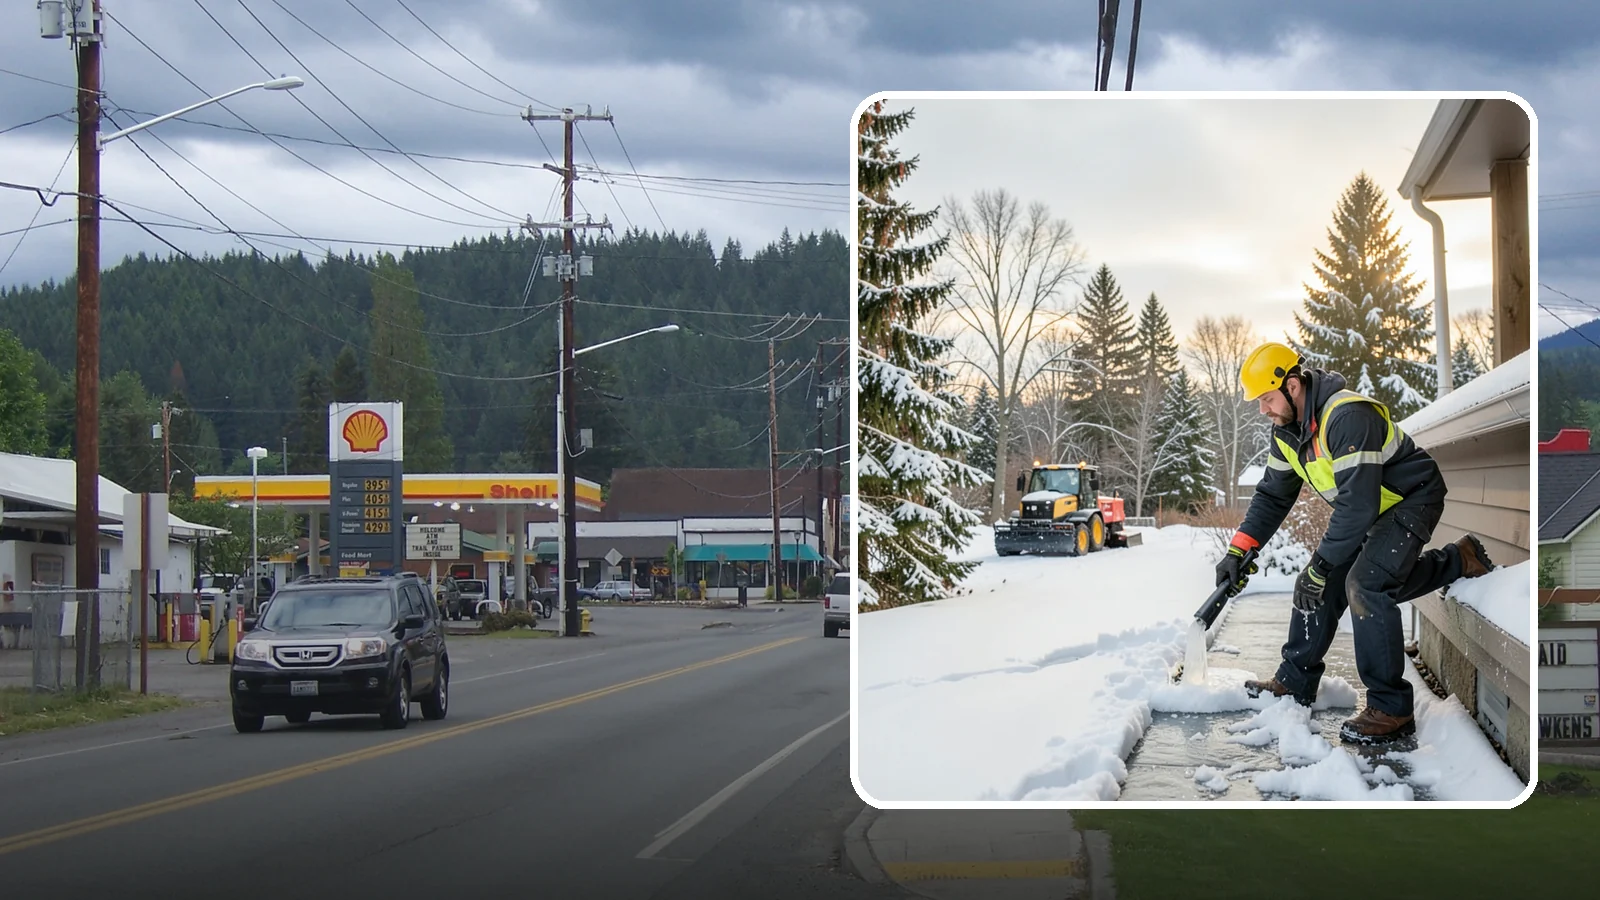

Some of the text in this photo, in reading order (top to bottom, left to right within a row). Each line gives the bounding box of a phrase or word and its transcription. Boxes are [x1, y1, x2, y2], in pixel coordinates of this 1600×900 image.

[366, 480, 383, 490] 395
[490, 484, 547, 499] Shell
[366, 494, 383, 504] 405
[366, 508, 383, 518] 415
[366, 522, 383, 533] 429
[1539, 642, 1567, 666] AID
